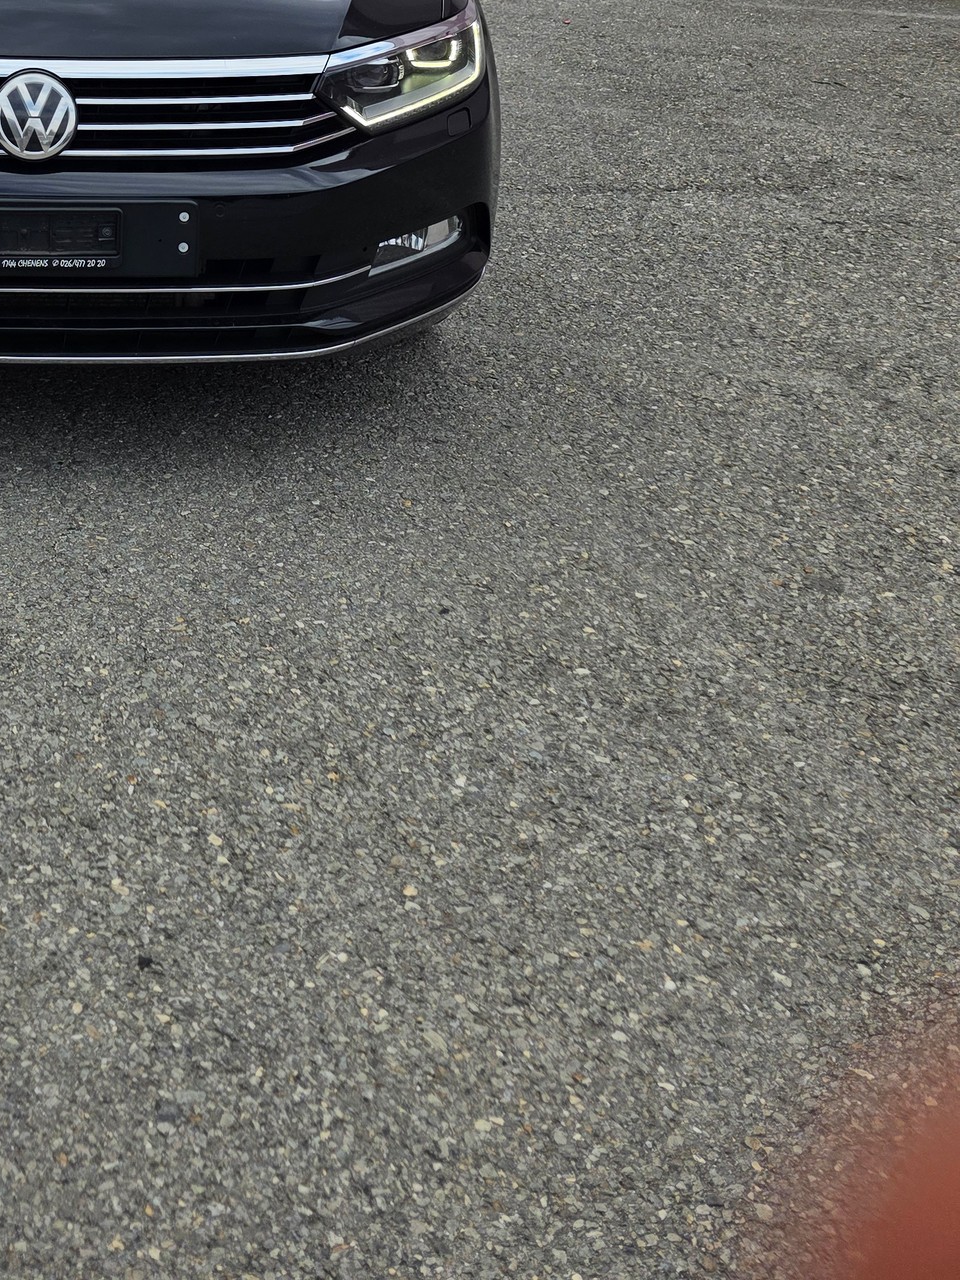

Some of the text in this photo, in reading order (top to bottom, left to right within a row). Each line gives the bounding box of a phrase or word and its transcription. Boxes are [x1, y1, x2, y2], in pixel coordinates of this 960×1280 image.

[17, 259, 49, 268] CHENENS
[87, 259, 96, 268] 20
[97, 259, 106, 268] 20
